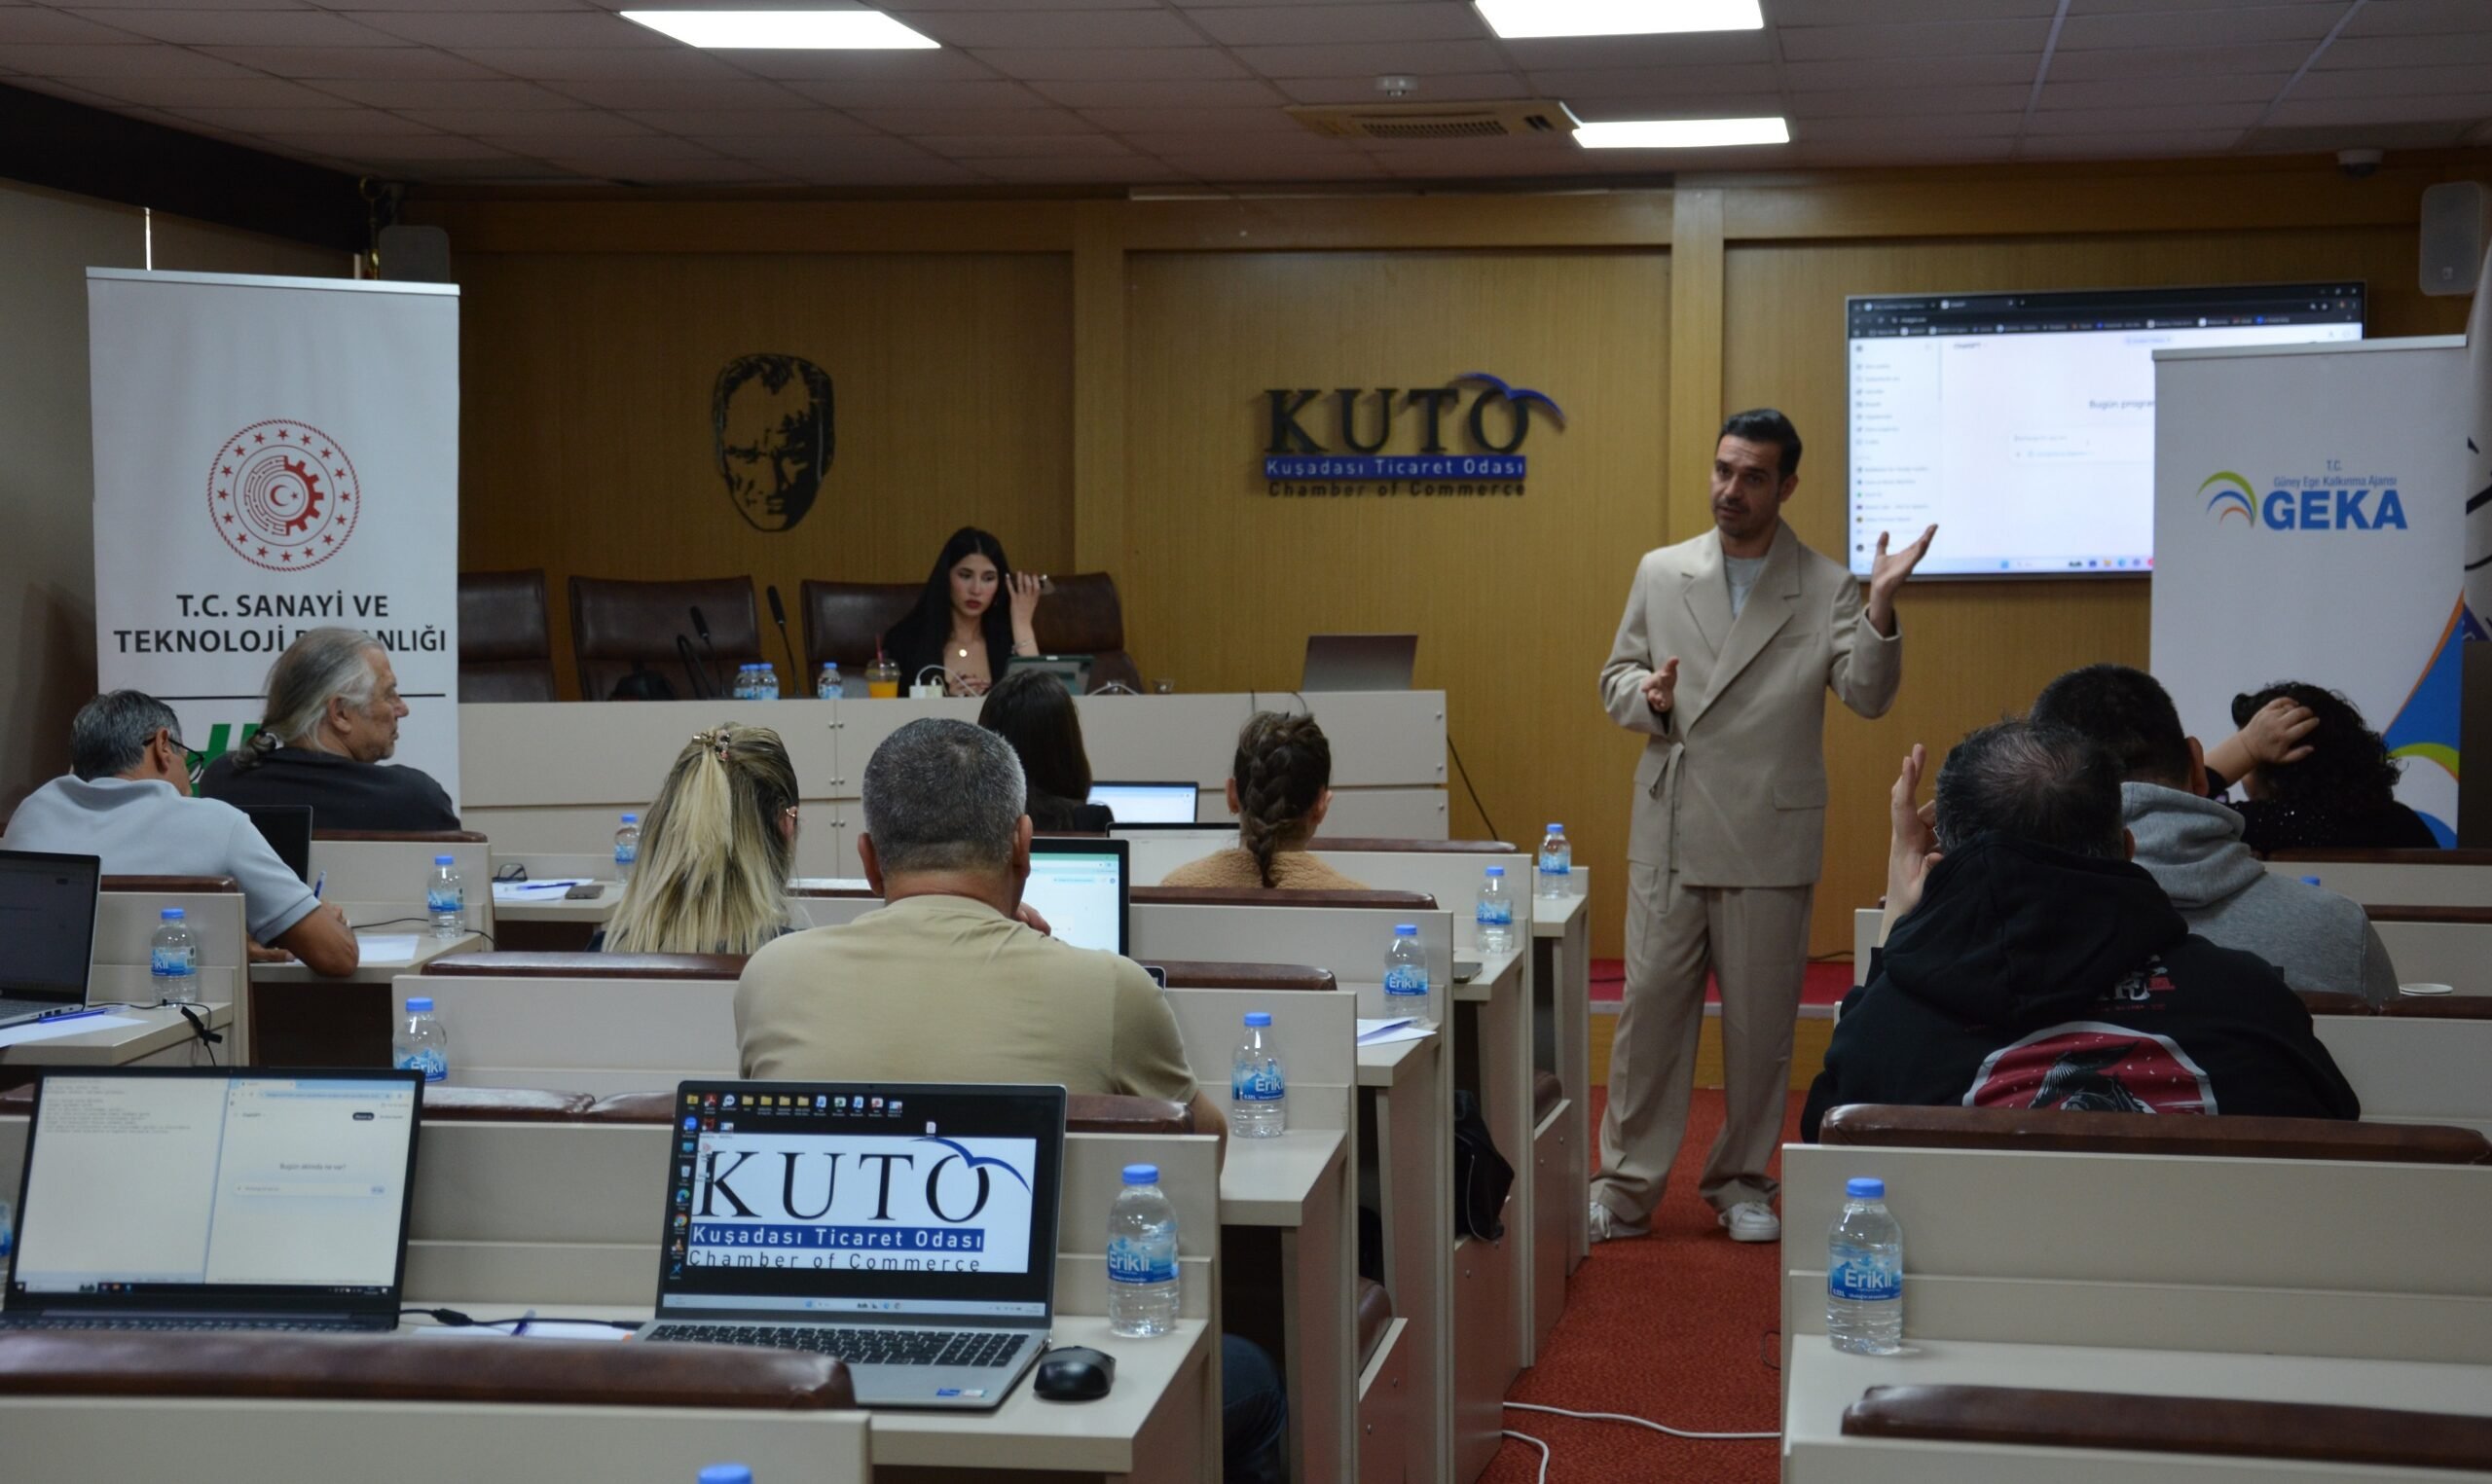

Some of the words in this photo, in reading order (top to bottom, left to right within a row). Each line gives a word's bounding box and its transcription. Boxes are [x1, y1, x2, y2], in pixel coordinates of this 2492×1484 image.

[1264, 387, 1529, 454] KUTO
[1266, 459, 1364, 477] Kuşadası
[1374, 458, 1453, 475] Ticaret
[1463, 458, 1523, 475] Odası
[1268, 481, 1365, 497] Chamber
[1377, 481, 1398, 497] of
[1409, 481, 1525, 497] Commerce
[2262, 489, 2408, 530] GEKA
[177, 595, 228, 617] T.C.
[237, 590, 343, 617] SANAYİ
[353, 596, 388, 617] VE
[113, 625, 283, 653] TEKNOLOJİ
[1389, 976, 1418, 990] Erikli
[692, 1150, 990, 1223] KUTO
[692, 1226, 802, 1245] Kuşadası
[815, 1228, 903, 1247] Ticaret
[915, 1230, 981, 1249] Odası
[689, 1249, 799, 1268] Chamber
[813, 1252, 836, 1269] of
[849, 1252, 980, 1272] Commerce
[1109, 1249, 1151, 1273] Erikli
[1844, 1268, 1892, 1289] Erikli
